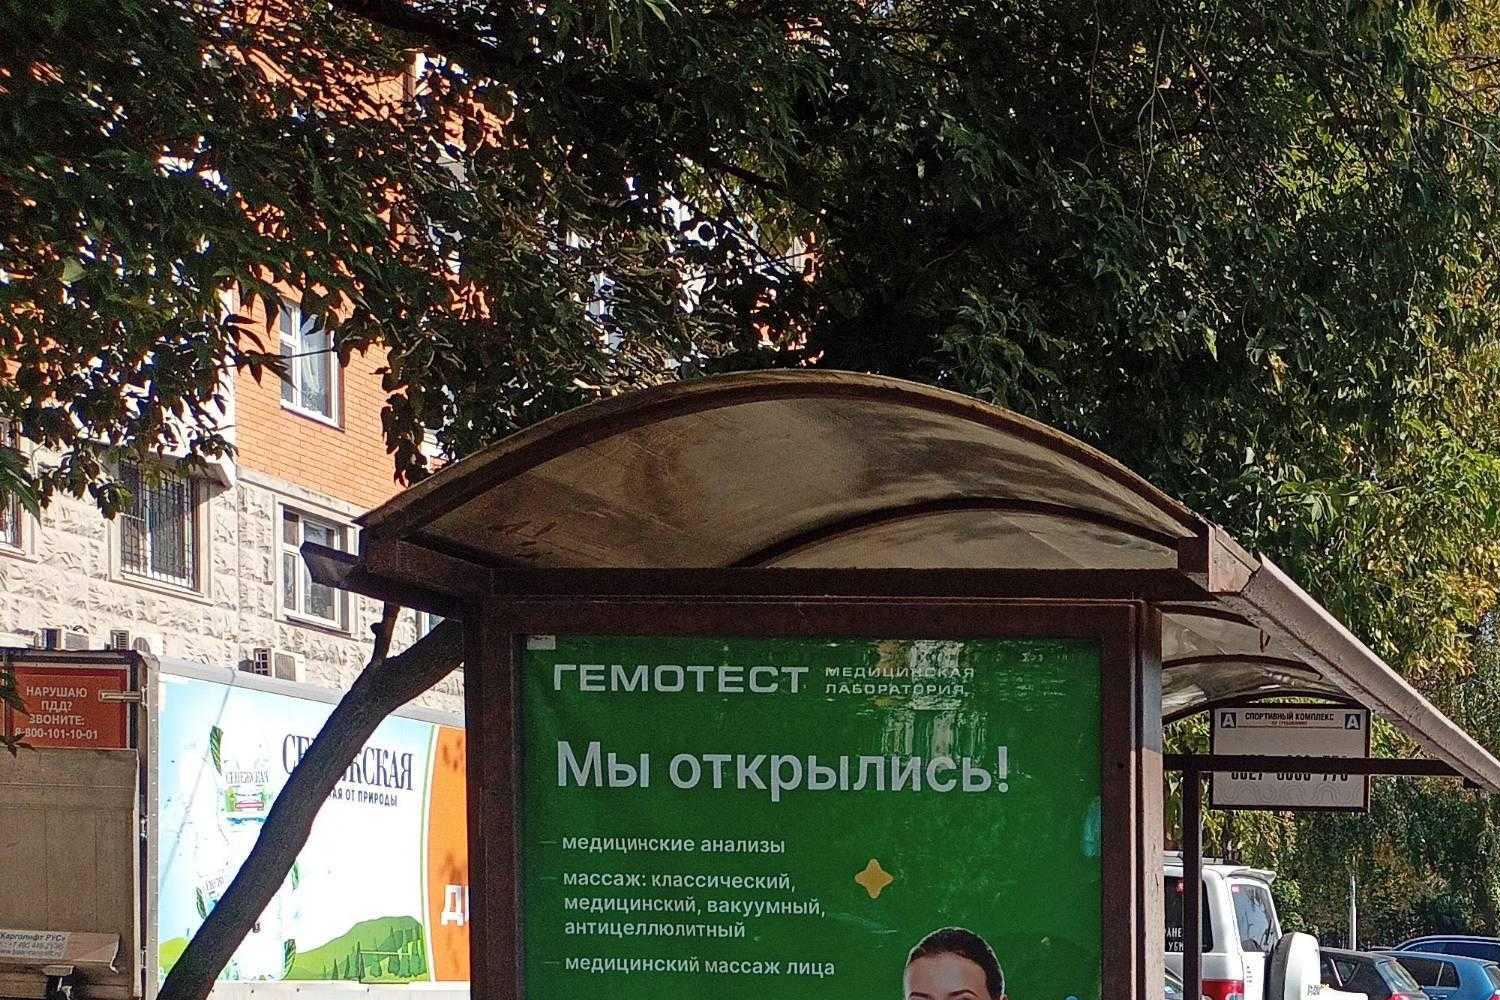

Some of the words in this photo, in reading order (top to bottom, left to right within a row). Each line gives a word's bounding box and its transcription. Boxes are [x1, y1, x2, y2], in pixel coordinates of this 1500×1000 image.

[552, 664, 809, 693] ГЕМОТЕСТ
[825, 667, 975, 680] МЕДИЦИНСКАЯ
[26, 686, 88, 698] НАРУШАЮ
[825, 684, 965, 695] ЛАБОРАТОРИЯ
[41, 700, 73, 713] ПДД?
[29, 713, 85, 726] ЗВОНИТЕ:
[1244, 711, 1294, 721] СПОРТИВНЫЙ
[1295, 712, 1335, 721] КОМПЛЕКС
[15, 728, 98, 740] 8-800-101-10-01
[557, 740, 649, 788] Мы
[669, 746, 1009, 802] открылись!
[357, 790, 397, 807] ПРИРОДЫ
[562, 835, 695, 853] медицинские
[700, 838, 786, 853] анализы
[563, 872, 647, 887] массаж:
[652, 873, 796, 893] классический,
[564, 895, 702, 916] медицинский,
[707, 898, 826, 918] вакуумный,
[564, 920, 746, 938] антицеллюлитный
[565, 956, 700, 975] медицинский
[705, 959, 780, 974] массаж
[786, 961, 836, 978] лица
